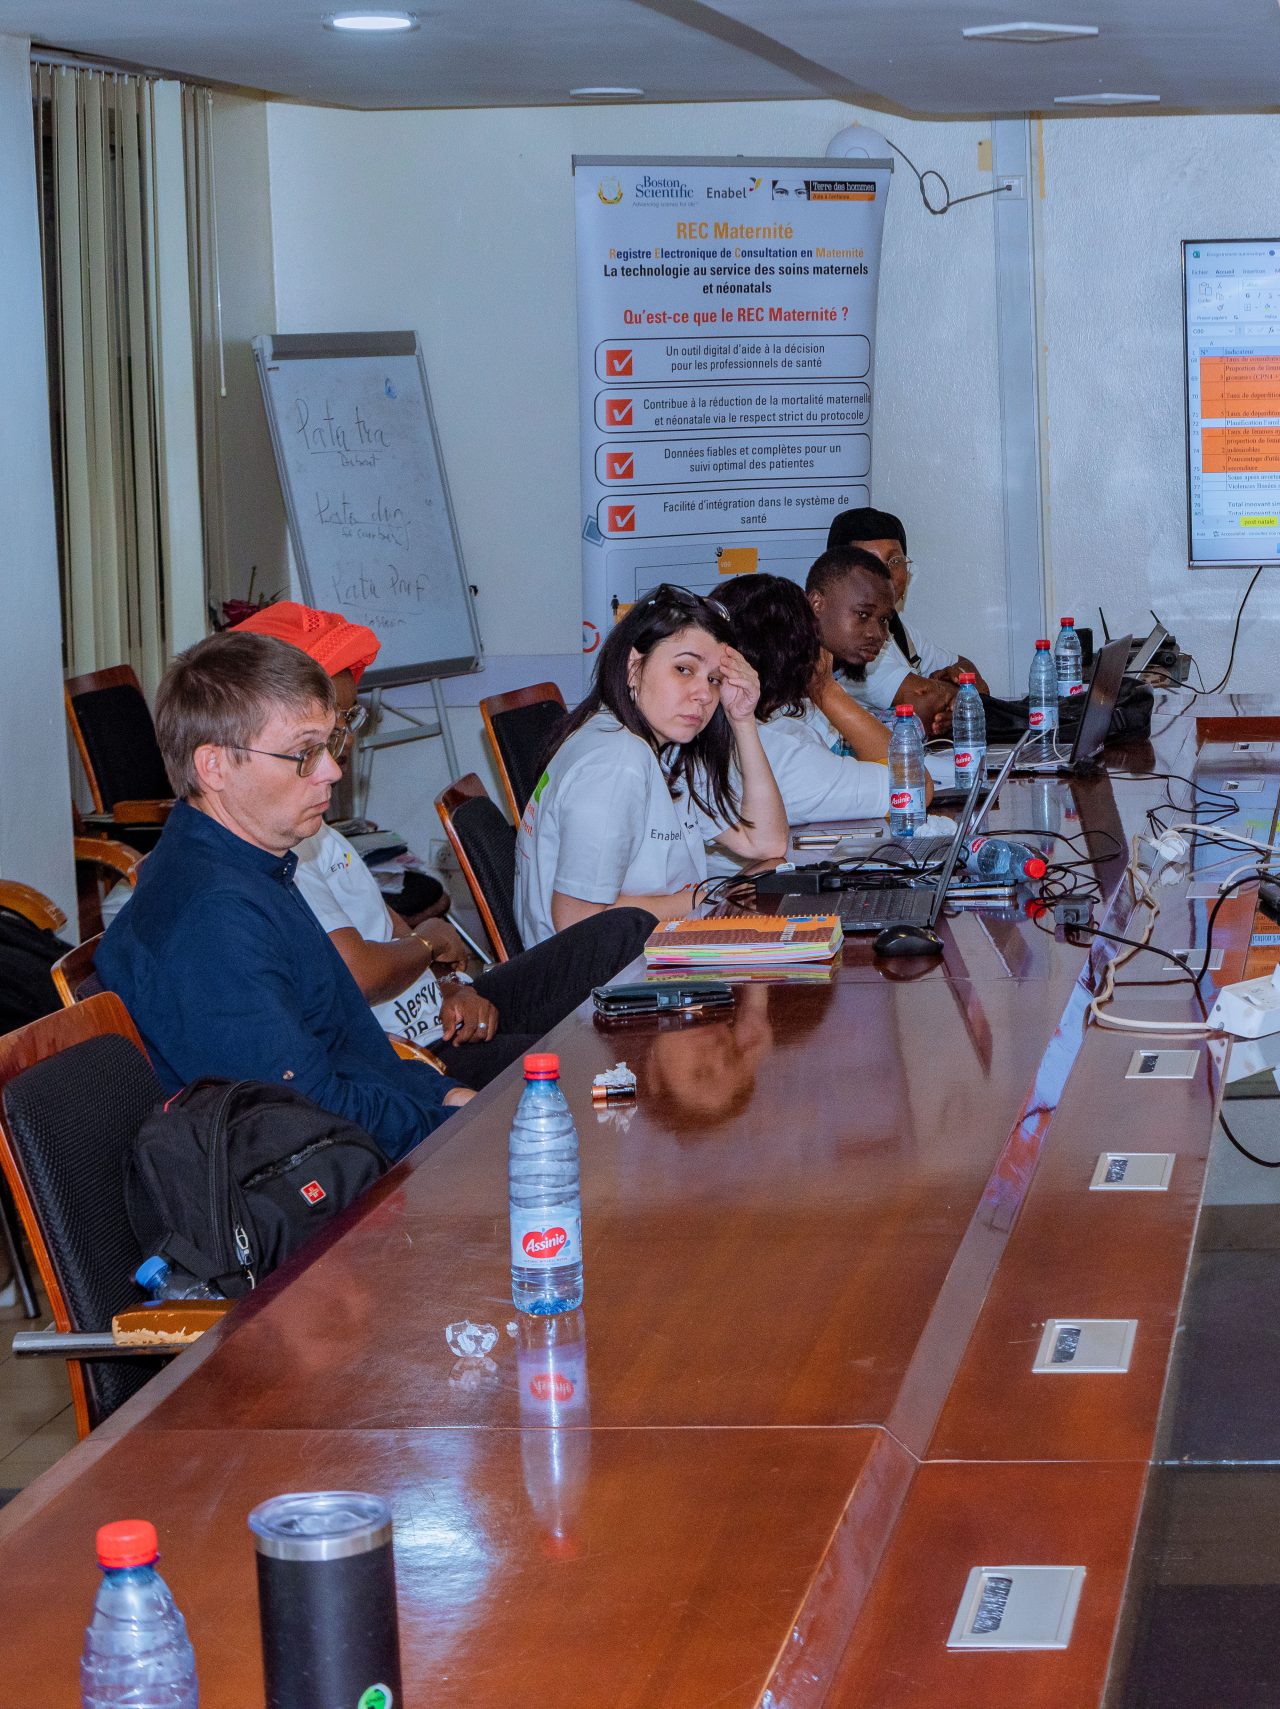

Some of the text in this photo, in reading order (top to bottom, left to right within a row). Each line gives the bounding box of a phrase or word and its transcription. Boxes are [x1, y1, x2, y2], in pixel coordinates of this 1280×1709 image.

[643, 176, 680, 188] Boston
[812, 182, 875, 191] Terre des hommes
[635, 184, 694, 199] Scientific
[706, 187, 747, 199] Enabel
[676, 221, 793, 240] REC Maternité
[609, 247, 864, 261] Registre Electronique de Consultation en Maternité
[603, 263, 869, 279] La technologie au service des soins maternels
[702, 281, 772, 294] et néonatals
[623, 306, 849, 327] Qu'est-ce que le REC Maternité ?
[666, 343, 825, 358] Un outil digital d'aide à la décision
[671, 357, 822, 373] pour les professionnels de santé
[643, 397, 688, 410] Contribue
[690, 397, 696, 408] à
[698, 397, 707, 408] la
[709, 395, 753, 408] réduction
[755, 395, 767, 406] de
[769, 395, 778, 406] la
[781, 394, 824, 405] mortalité
[654, 410, 864, 426] et néonatale via le respect strict du protocole
[664, 444, 841, 459] Données fiables et complètes pour un
[689, 458, 814, 473] suivi optimal des patientes
[663, 495, 849, 513] Facilité d'intégration dans le système de
[740, 513, 767, 524] santé
[650, 828, 682, 842] Enabel
[525, 1233, 565, 1253] Assinie
